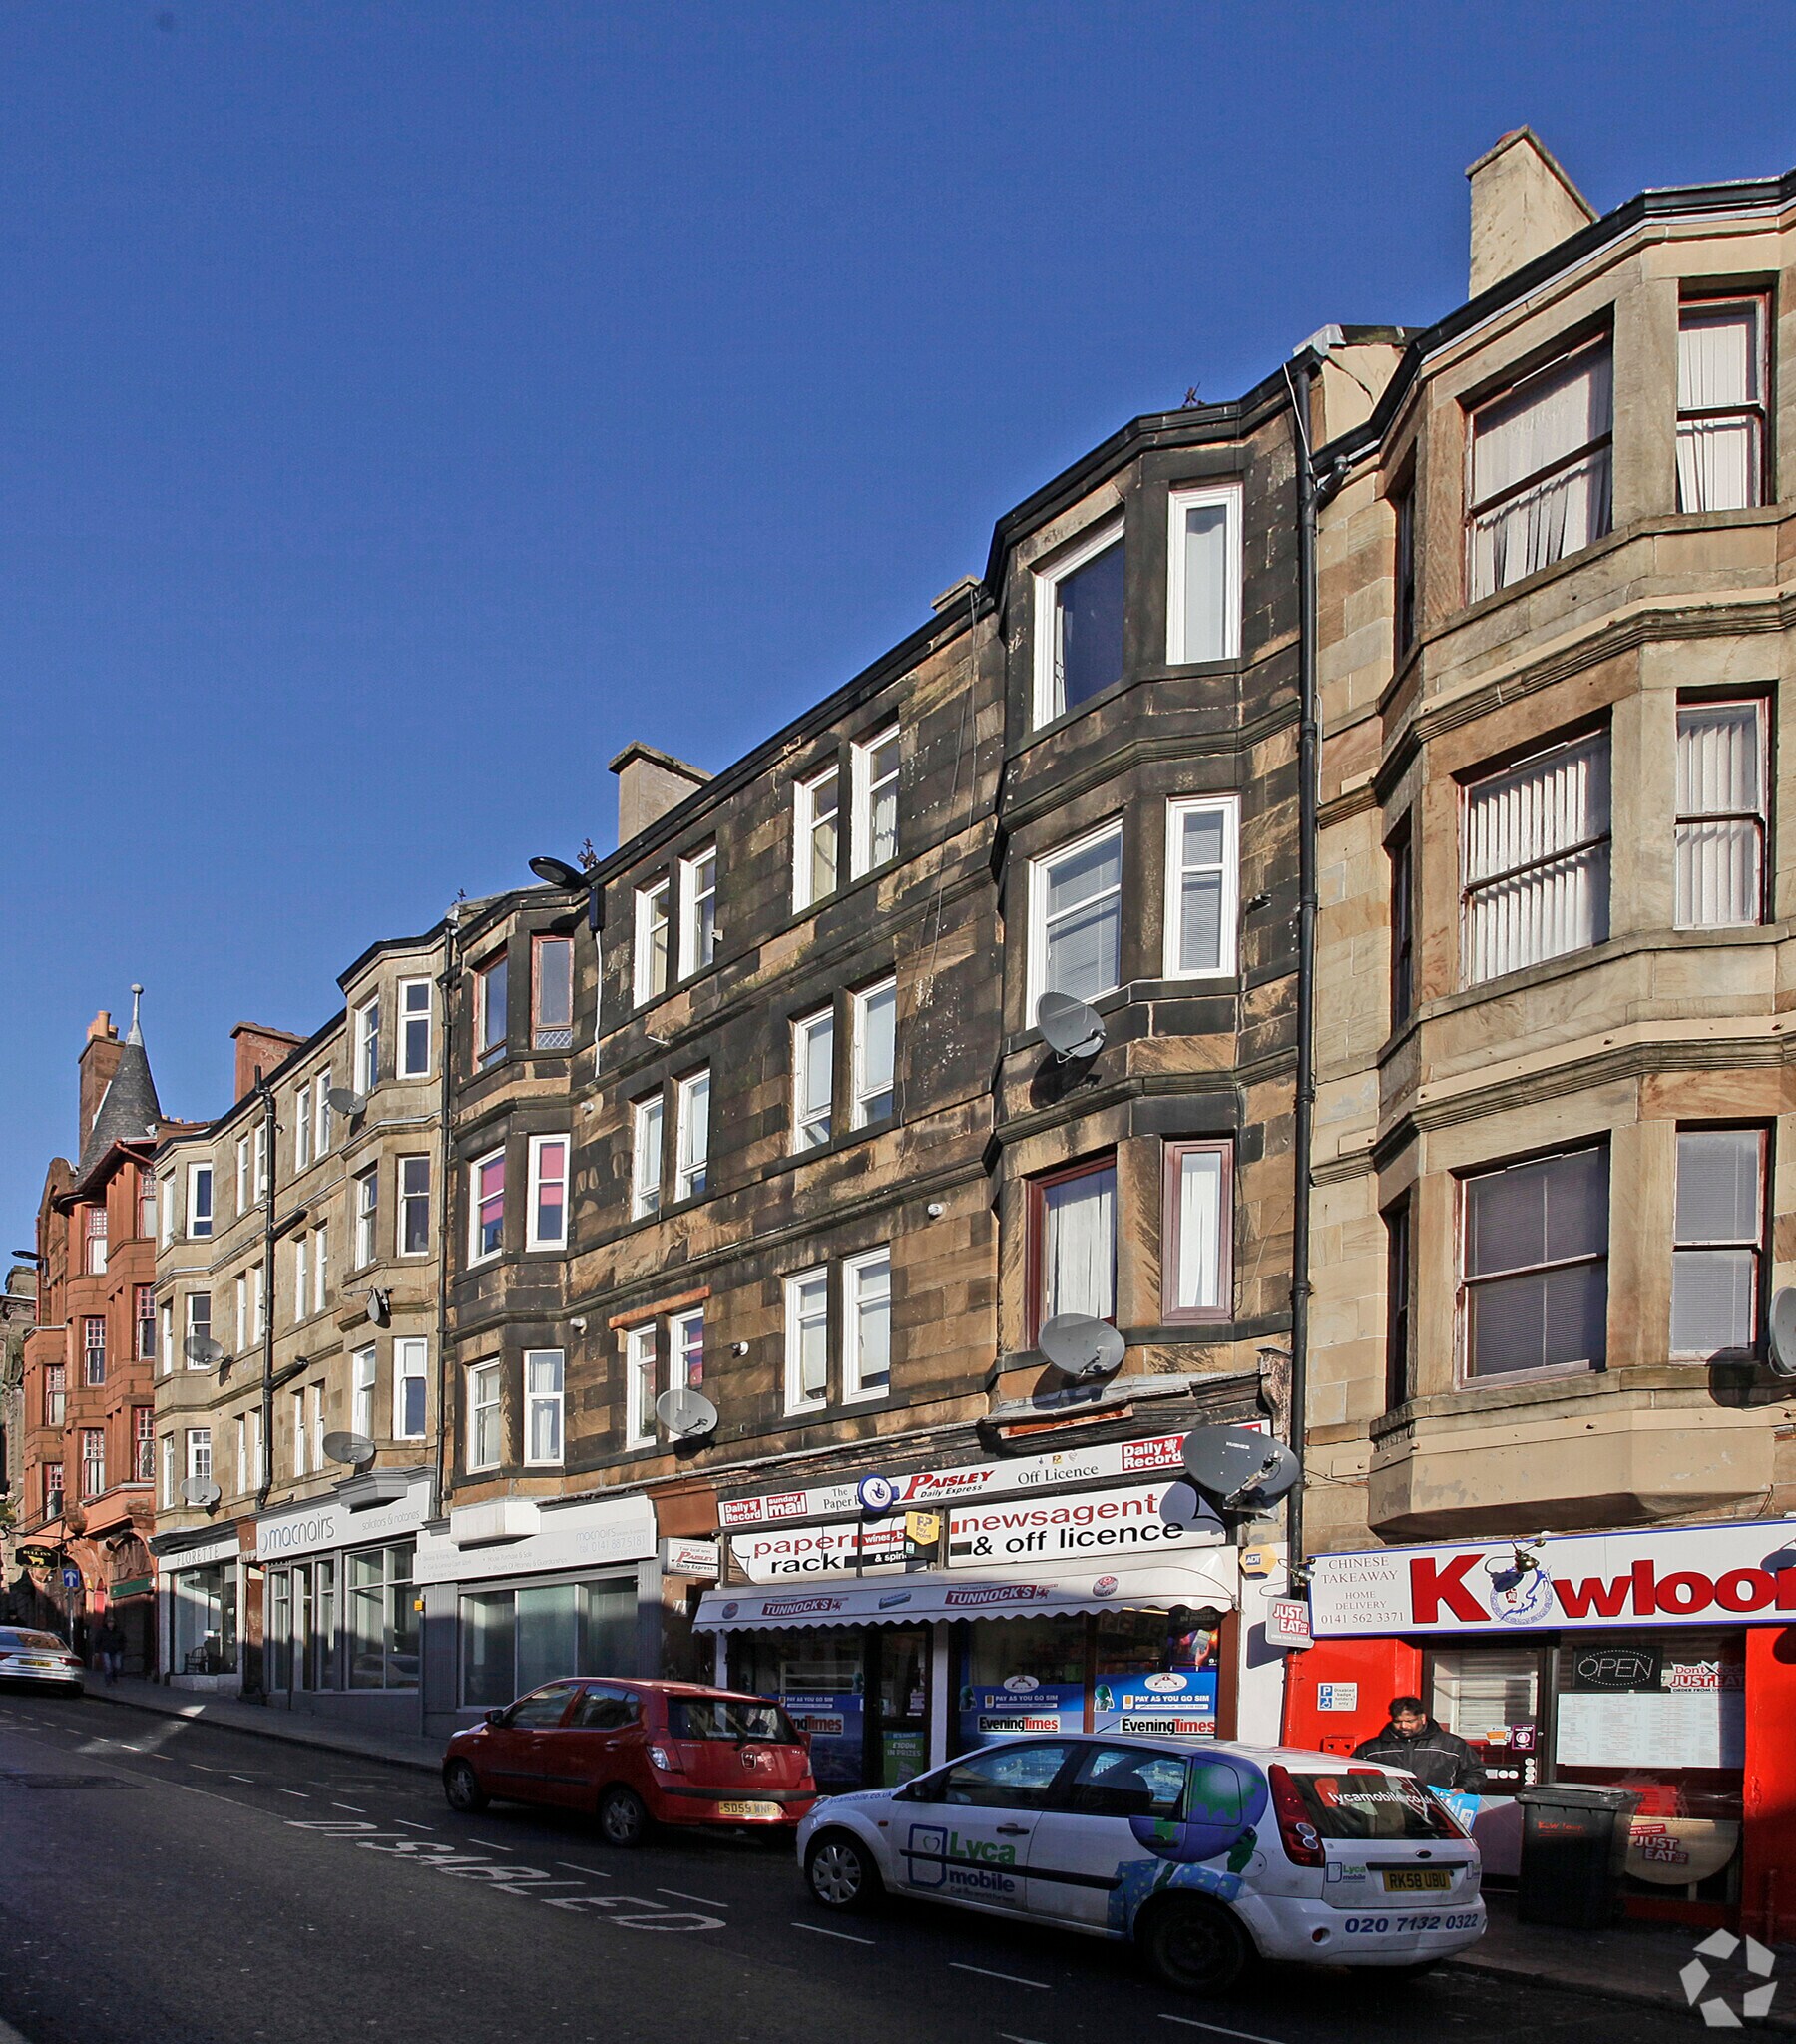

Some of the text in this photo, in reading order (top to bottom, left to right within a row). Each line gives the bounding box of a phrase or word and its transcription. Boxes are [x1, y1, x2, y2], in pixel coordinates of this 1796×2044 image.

[1123, 1440, 1163, 1458] Daily
[1123, 1450, 1183, 1468] Record
[1018, 1464, 1099, 1485] Off Licence
[832, 1488, 847, 1497] The
[920, 1483, 983, 1499] Daily Express
[725, 1501, 749, 1514] Daily
[768, 1495, 799, 1505] sunday
[768, 1495, 807, 1518] mail
[823, 1498, 853, 1510] Paper
[725, 1510, 761, 1523] Record
[961, 1494, 1158, 1533] newsagent
[268, 1513, 335, 1549] macnairs
[973, 1522, 1184, 1556] & off licence
[592, 1541, 609, 1552] 0141
[754, 1534, 851, 1559] paper
[177, 1544, 220, 1567] FLORETTE
[771, 1553, 842, 1574] rack
[874, 1553, 882, 1563] &
[1246, 1555, 1260, 1564] ADT
[1328, 1557, 1389, 1569] CHINESE
[1321, 1570, 1398, 1584] TAKEAWAY
[954, 1586, 1032, 1604] TUNNOCK'S
[765, 1599, 830, 1615] TUNNOCK'S
[1273, 1604, 1303, 1620] JUST
[1335, 1601, 1387, 1610] DELIVERY
[1280, 1619, 1301, 1633] EAT
[1321, 1612, 1404, 1624] 0141 562 3371
[1577, 1658, 1654, 1678] OPEN
[1675, 1665, 1705, 1675] Don't
[1671, 1675, 1712, 1687] JUST
[950, 1832, 1016, 1866] Lyca
[1636, 1836, 1678, 1850] JUST
[1645, 1848, 1676, 1862] EAT
[283, 1820, 727, 1931] DISABLED
[1343, 1864, 1366, 1874] Lyca
[950, 1870, 1015, 1892] mobile
[1389, 1870, 1446, 1889] RK58 UBU
[1345, 1913, 1478, 1933] 020 7132 0322
